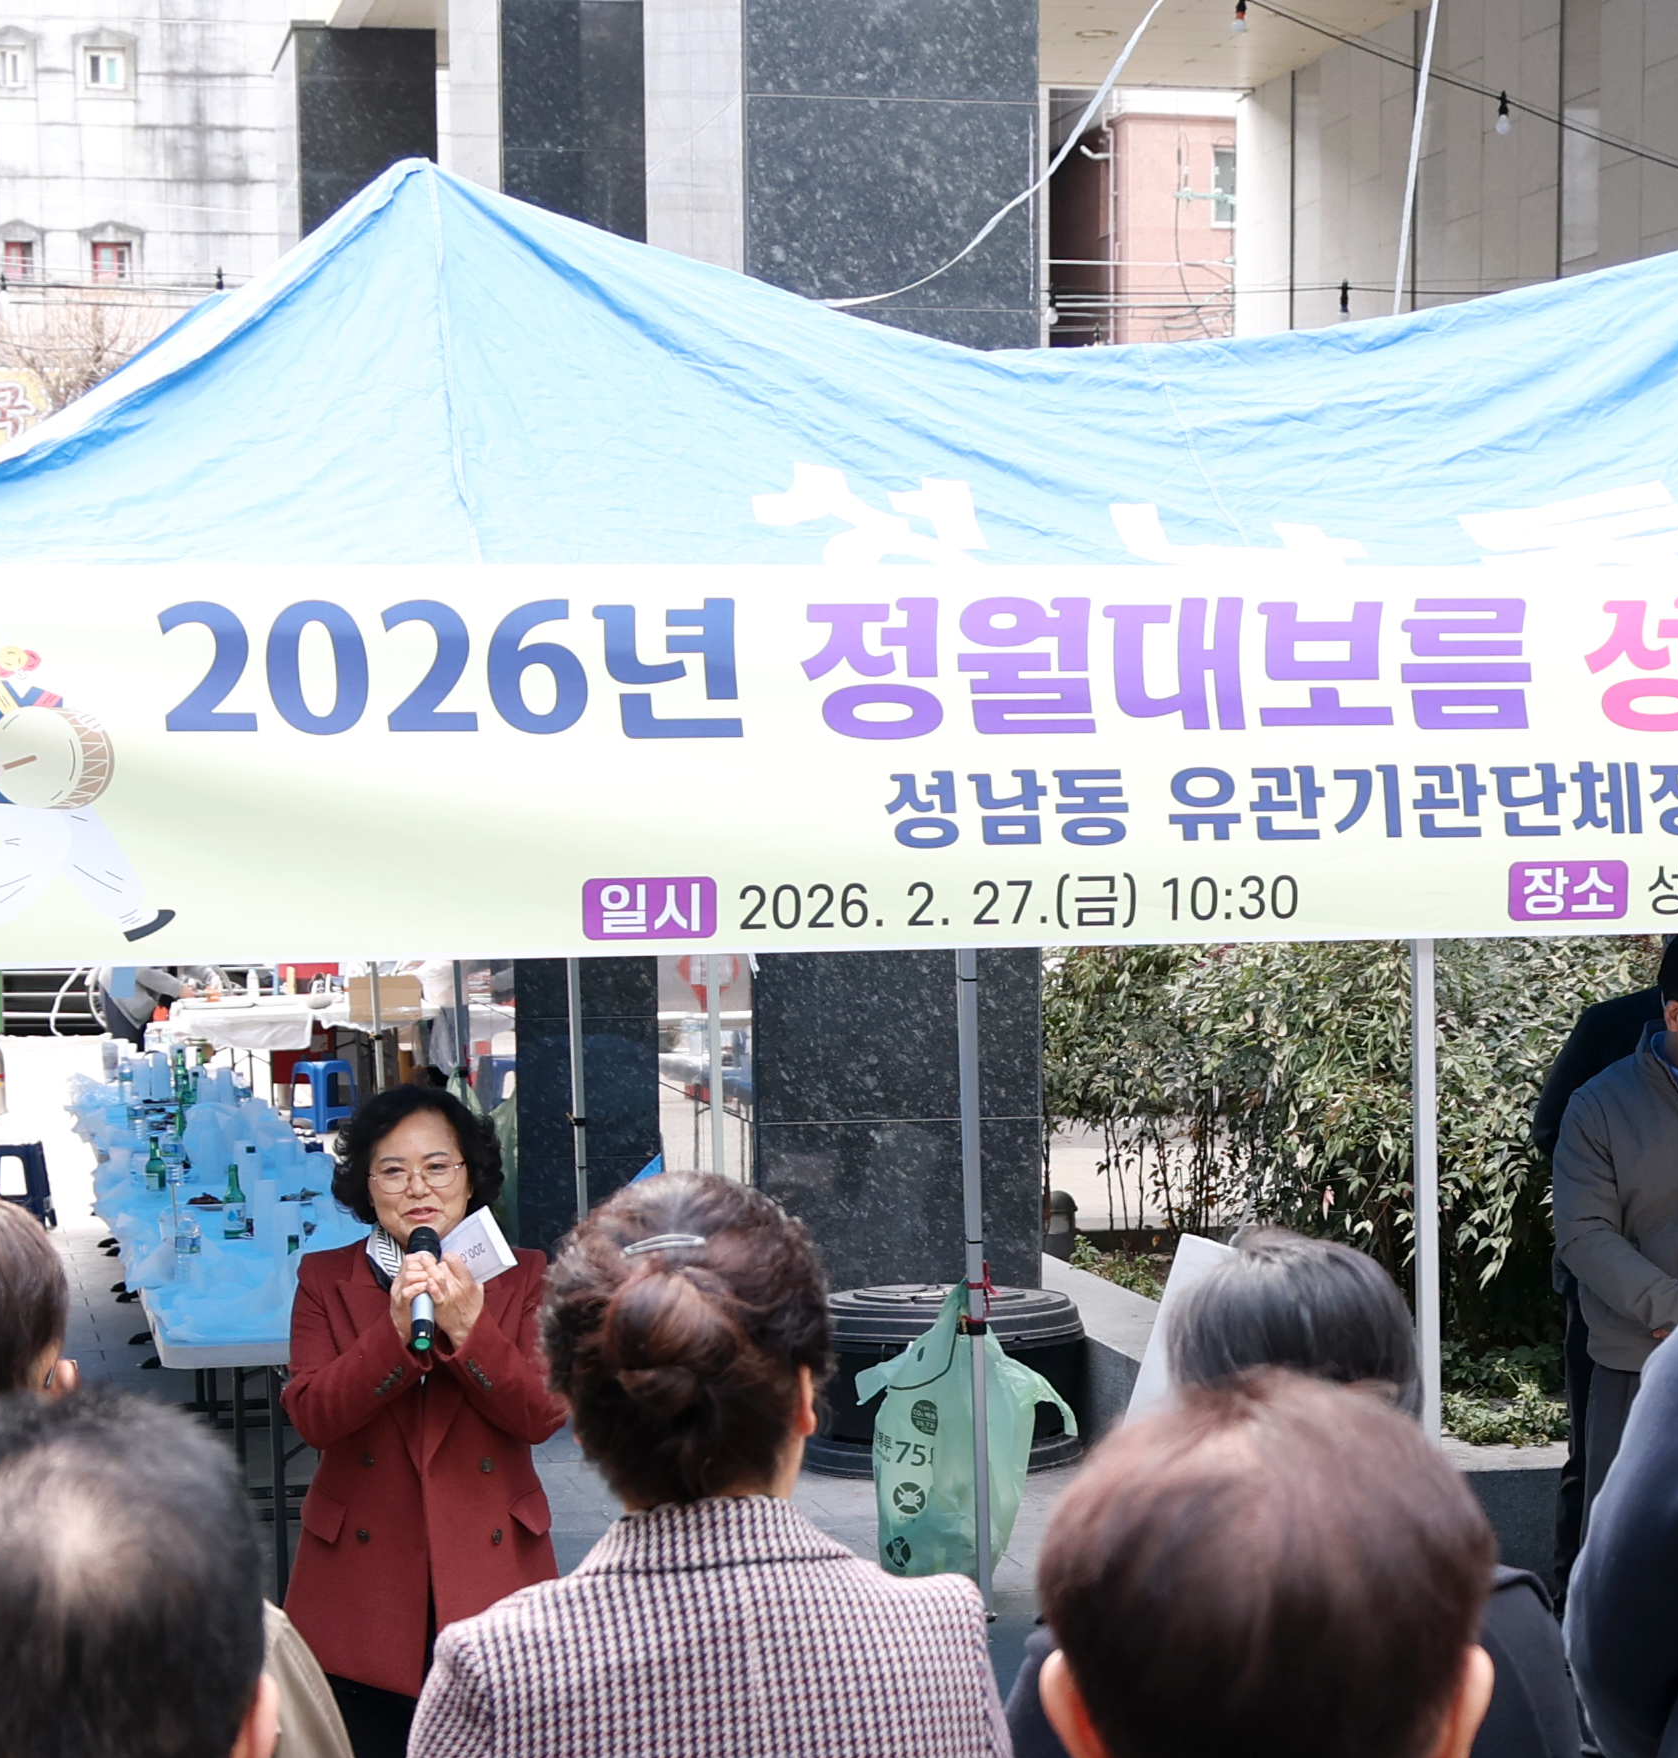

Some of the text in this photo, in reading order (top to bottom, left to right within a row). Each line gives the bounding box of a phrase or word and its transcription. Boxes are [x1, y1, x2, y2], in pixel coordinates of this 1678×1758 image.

[156, 597, 744, 740] 2026년
[800, 596, 1532, 740] 정월대보름
[883, 768, 1129, 850] 성남동
[599, 882, 702, 934] 일시
[739, 872, 1300, 930] 2026. 2. 27.(금) 10:30
[1522, 866, 1616, 916] 장소
